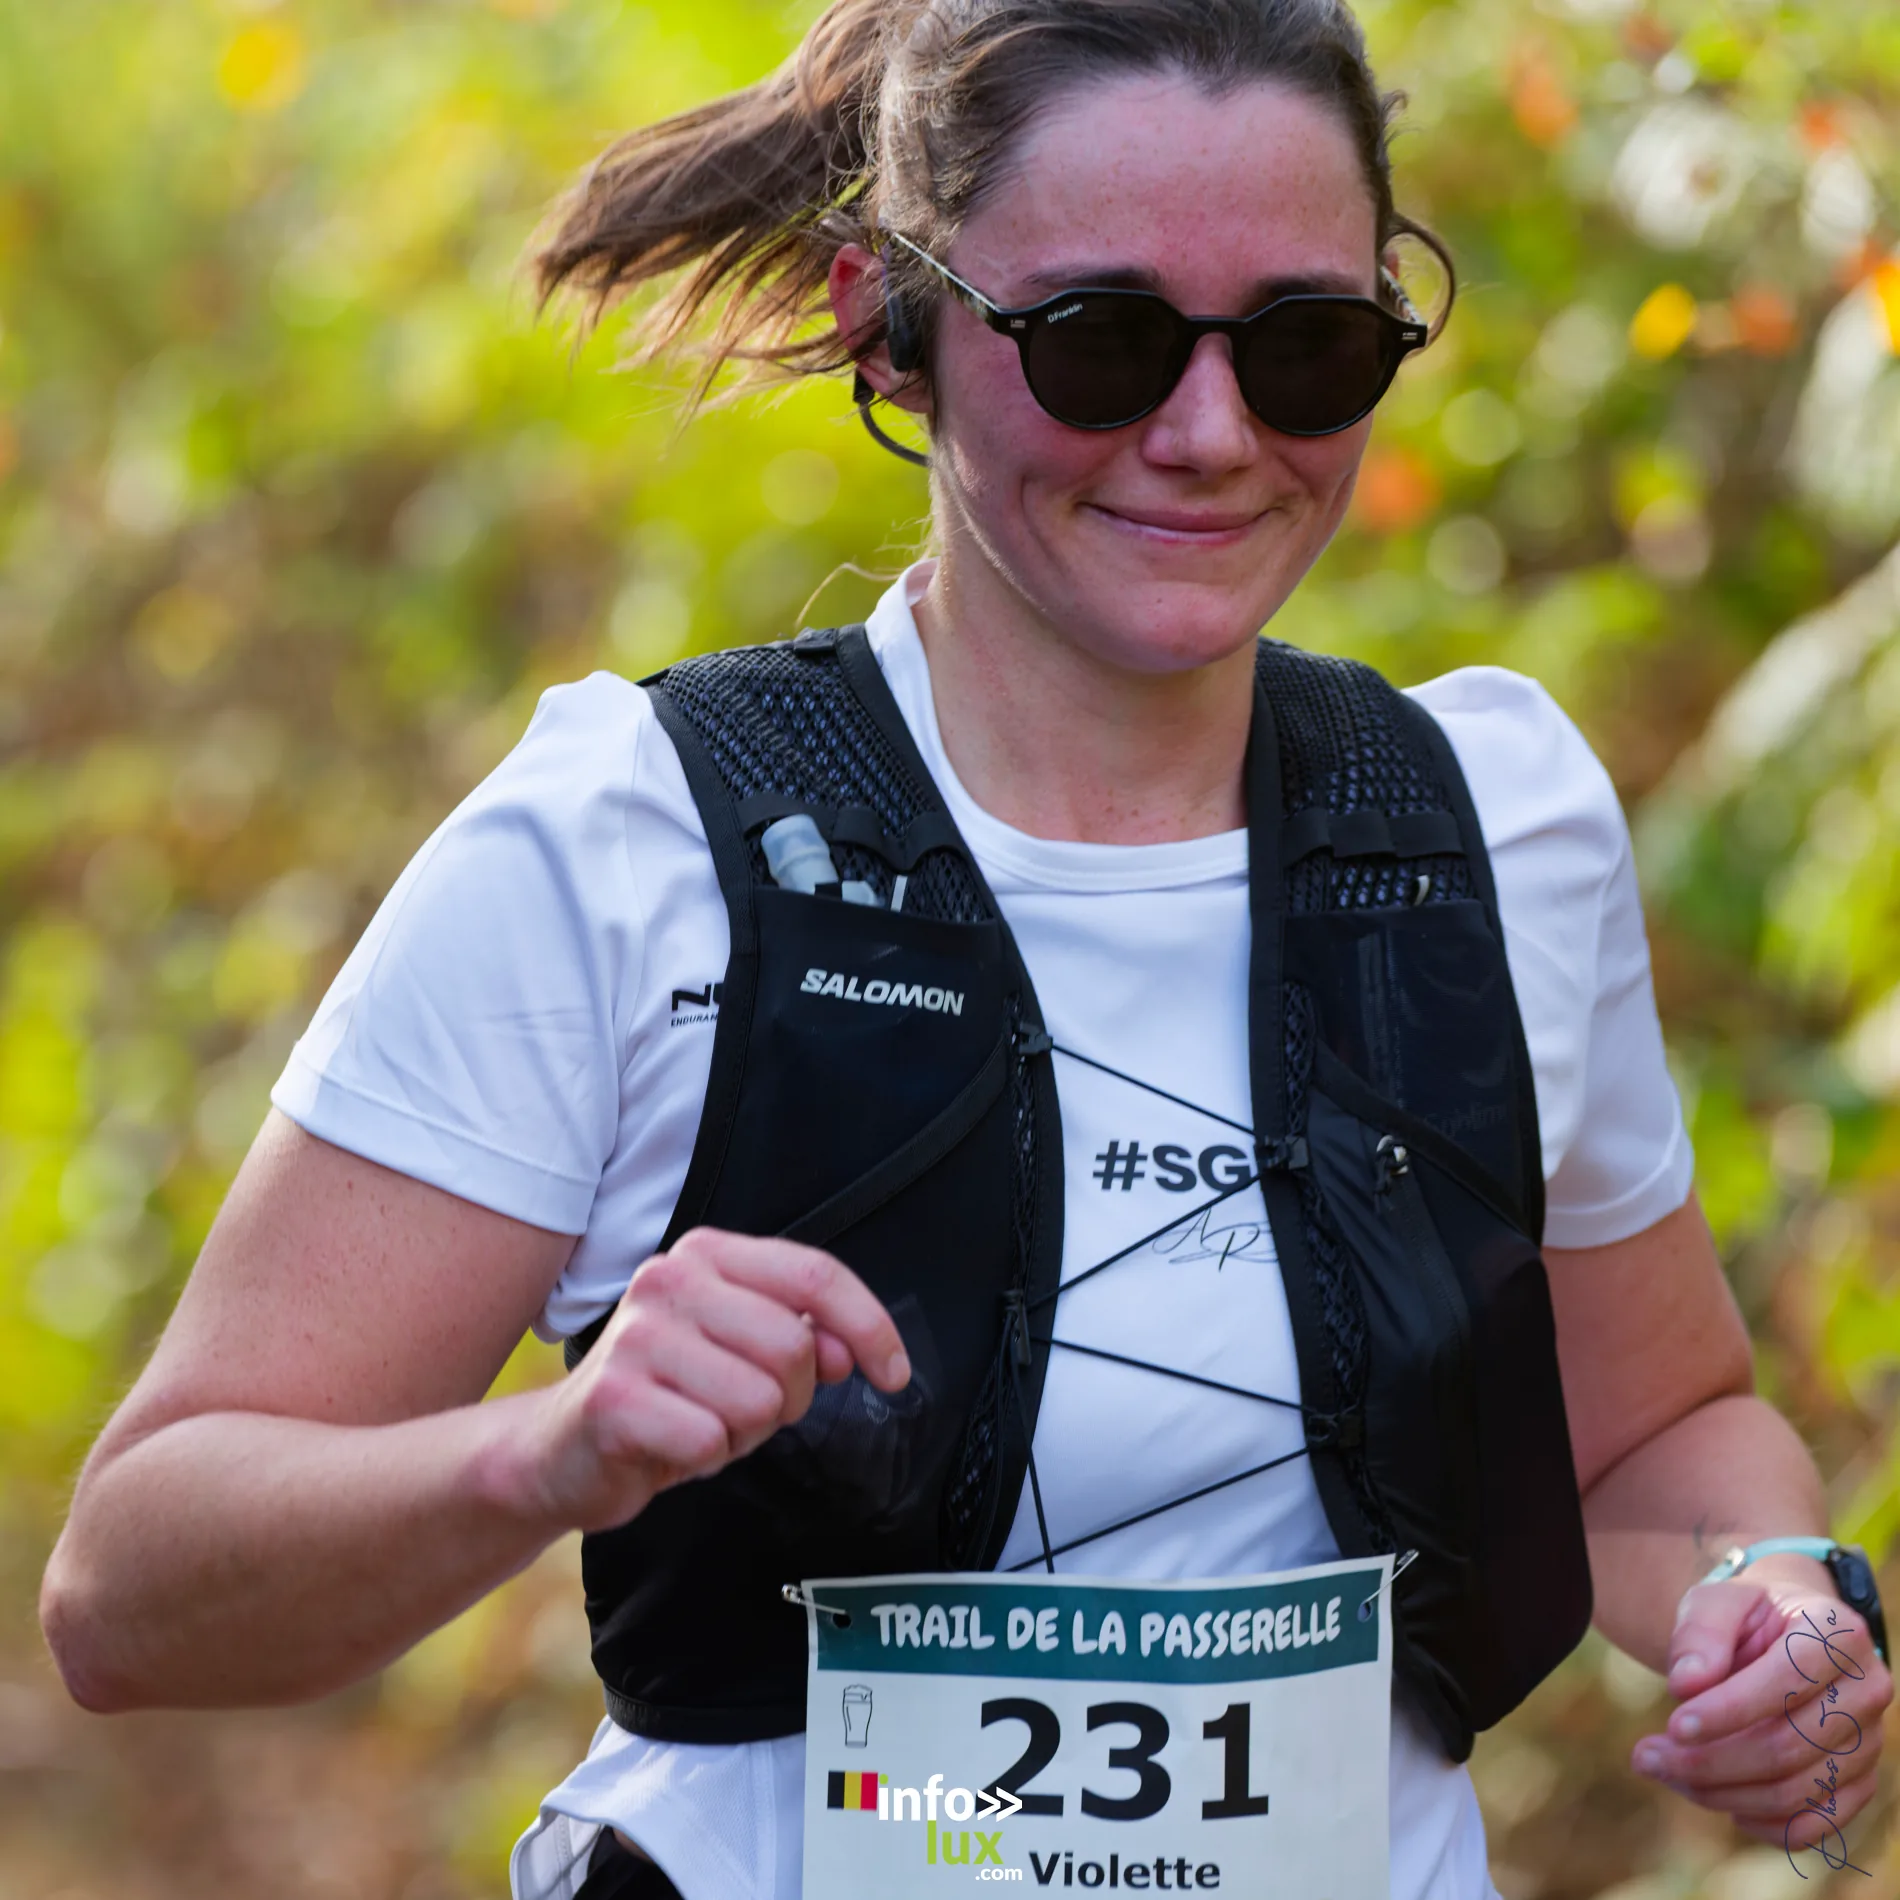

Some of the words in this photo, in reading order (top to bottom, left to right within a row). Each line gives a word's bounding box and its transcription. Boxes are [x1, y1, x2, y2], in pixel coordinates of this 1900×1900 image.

[800, 967, 965, 1017] SALOMON
[871, 1603, 995, 1651] TRAIL
[1006, 1607, 1060, 1653] DE
[1072, 1610, 1127, 1656] LA
[1140, 1595, 1342, 1660] PASSERELLE
[980, 1697, 1269, 1823] 231
[1028, 1850, 1221, 1891] Violette
